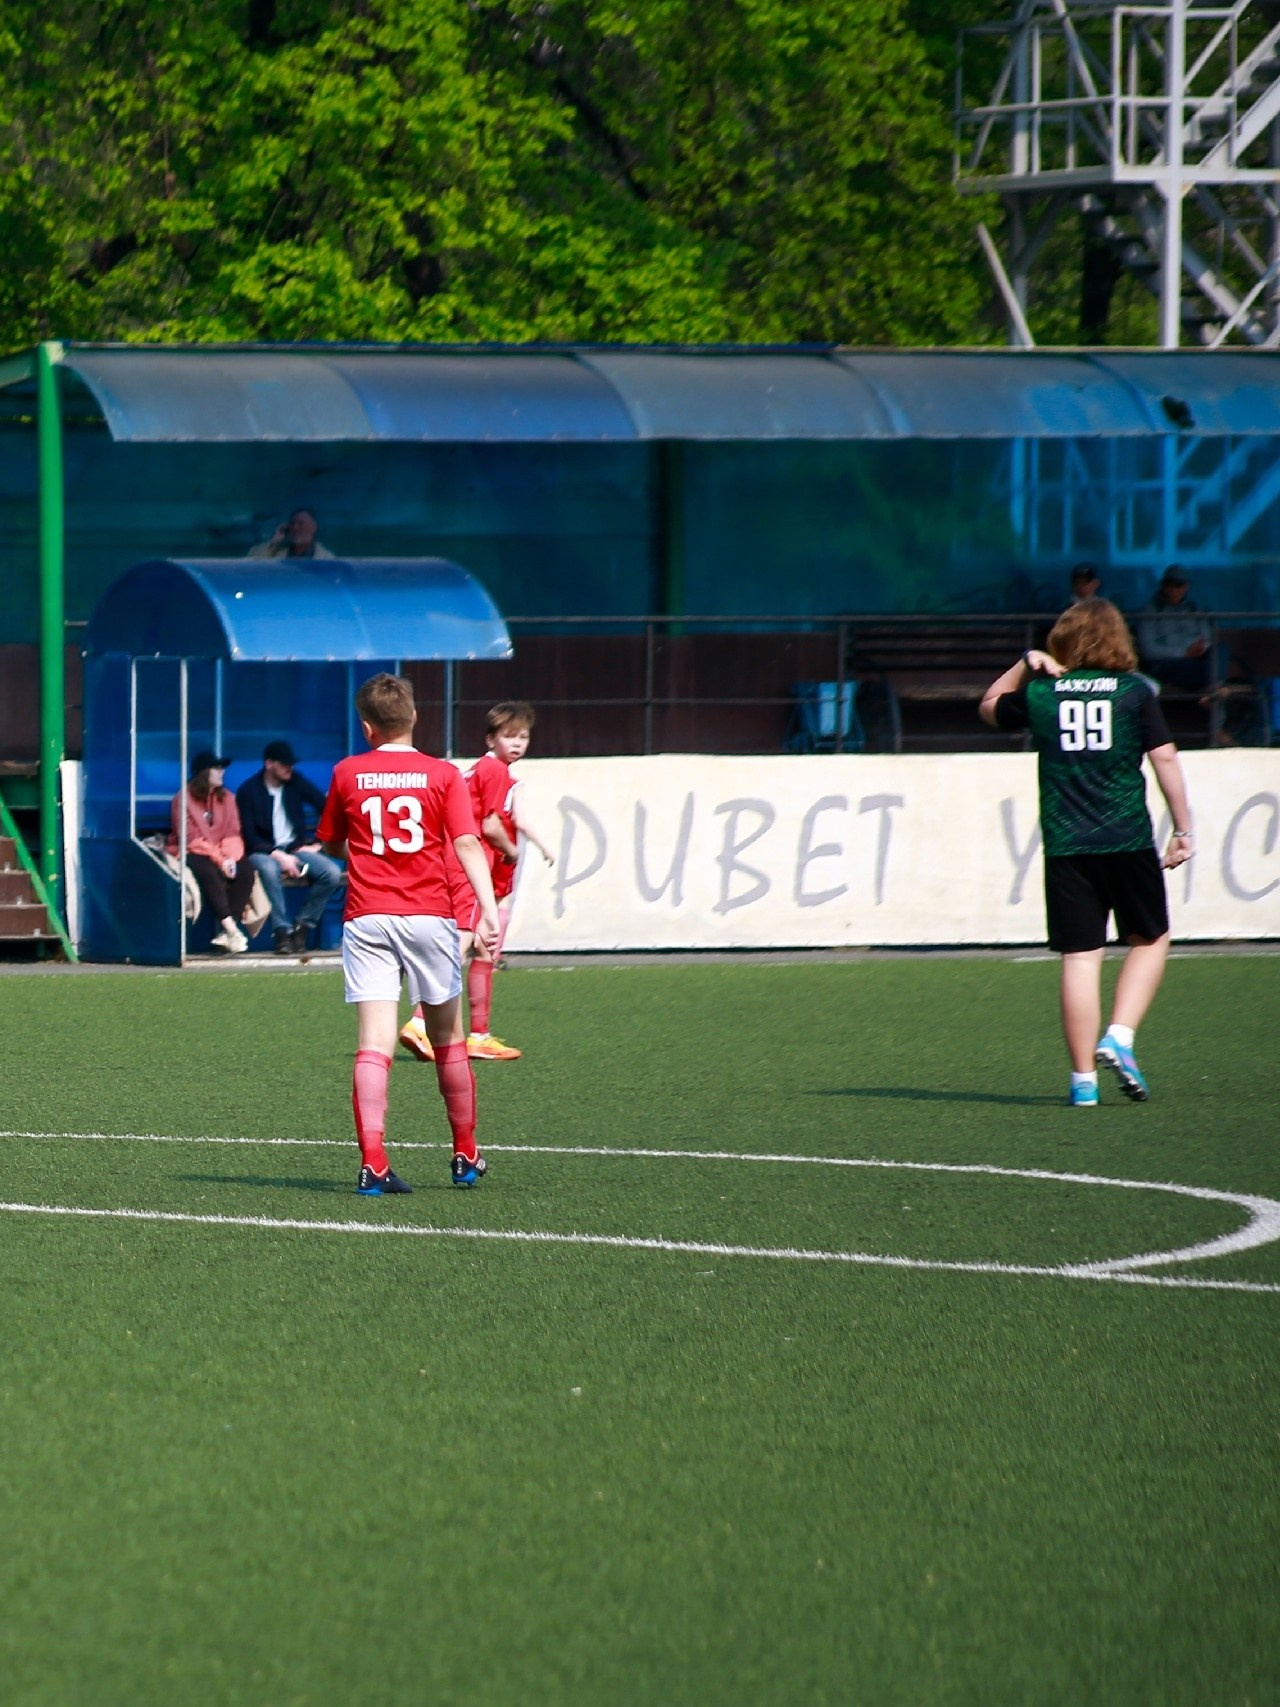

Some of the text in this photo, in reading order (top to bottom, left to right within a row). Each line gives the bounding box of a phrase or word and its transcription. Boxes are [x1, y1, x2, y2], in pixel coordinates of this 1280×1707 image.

[1058, 699, 1113, 752] 99
[355, 772, 428, 790] ТЕНЮНИН
[360, 795, 424, 856] 13
[507, 791, 904, 920] РИВЕТ
